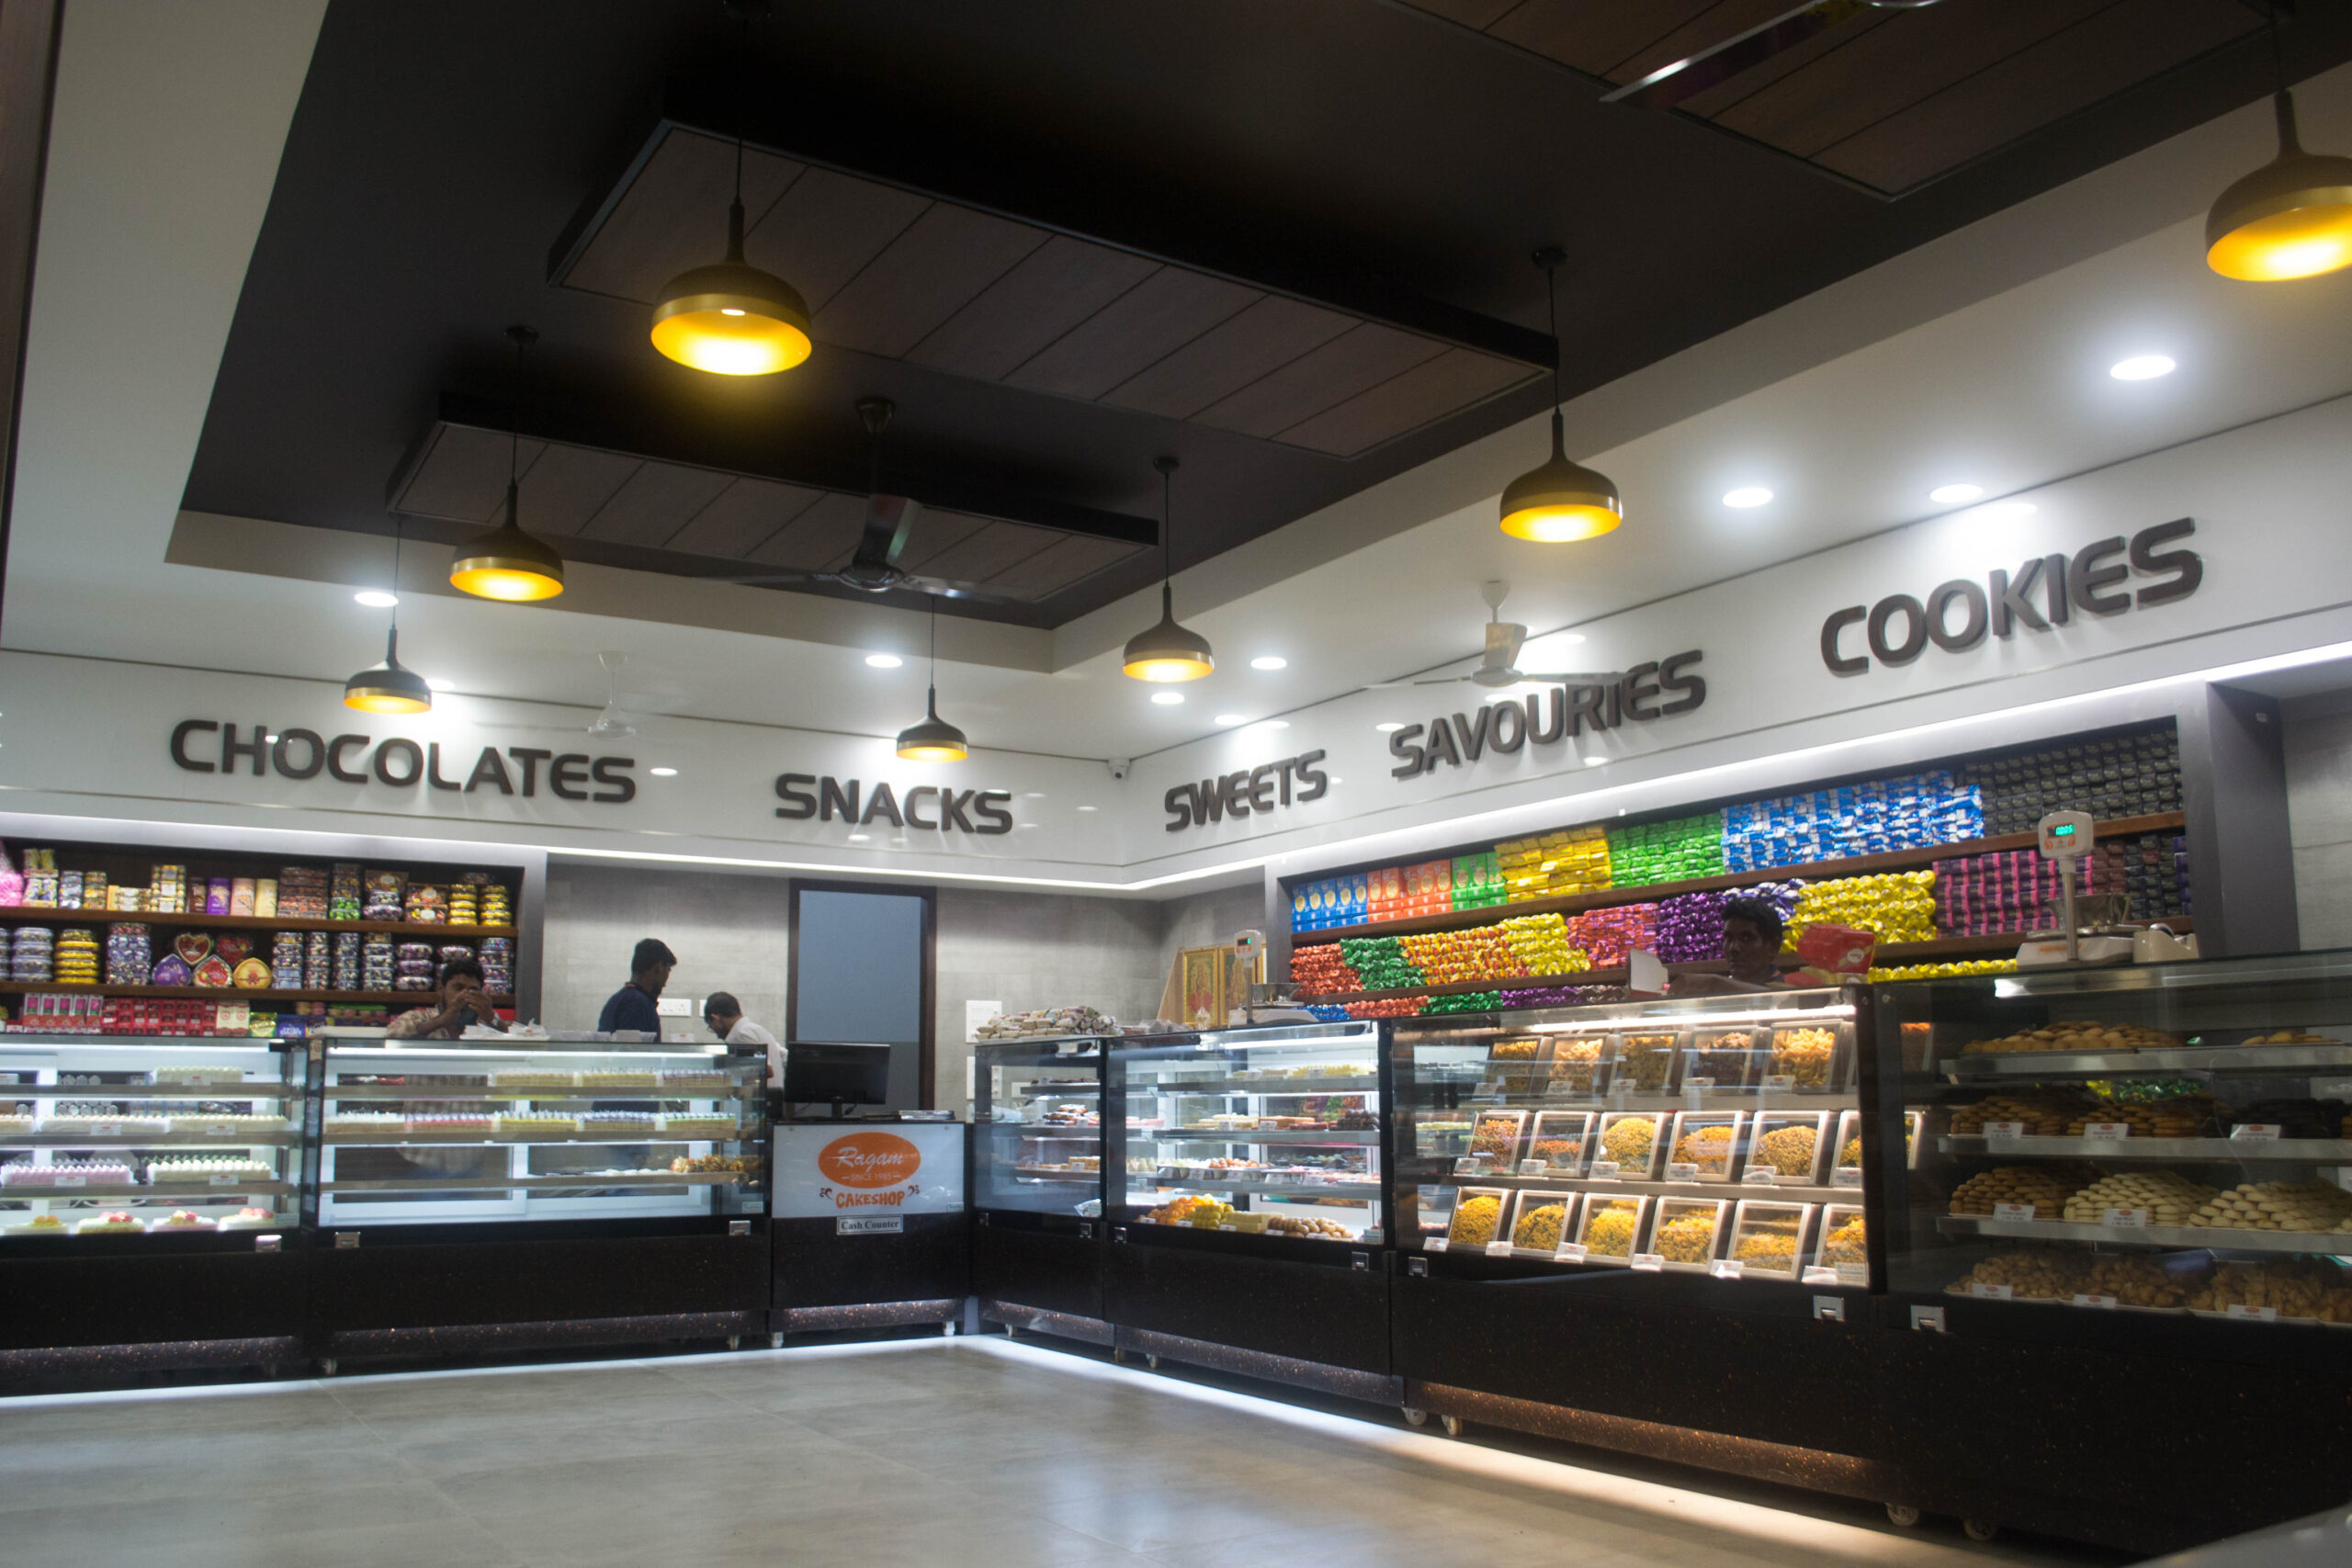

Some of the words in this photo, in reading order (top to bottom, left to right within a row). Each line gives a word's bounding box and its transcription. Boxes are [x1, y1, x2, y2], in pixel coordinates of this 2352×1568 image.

[1820, 516, 2204, 675] COOKIES
[1387, 649, 1707, 778] SAVOURIES
[169, 718, 637, 804] CHOCOLATES
[1164, 749, 1329, 833] SWEETS
[774, 773, 1014, 835] SNACKS
[837, 1146, 904, 1172] Ragam
[836, 1190, 905, 1208] CAKESHOP
[841, 1221, 863, 1230] Cash
[865, 1219, 899, 1229] Counter
